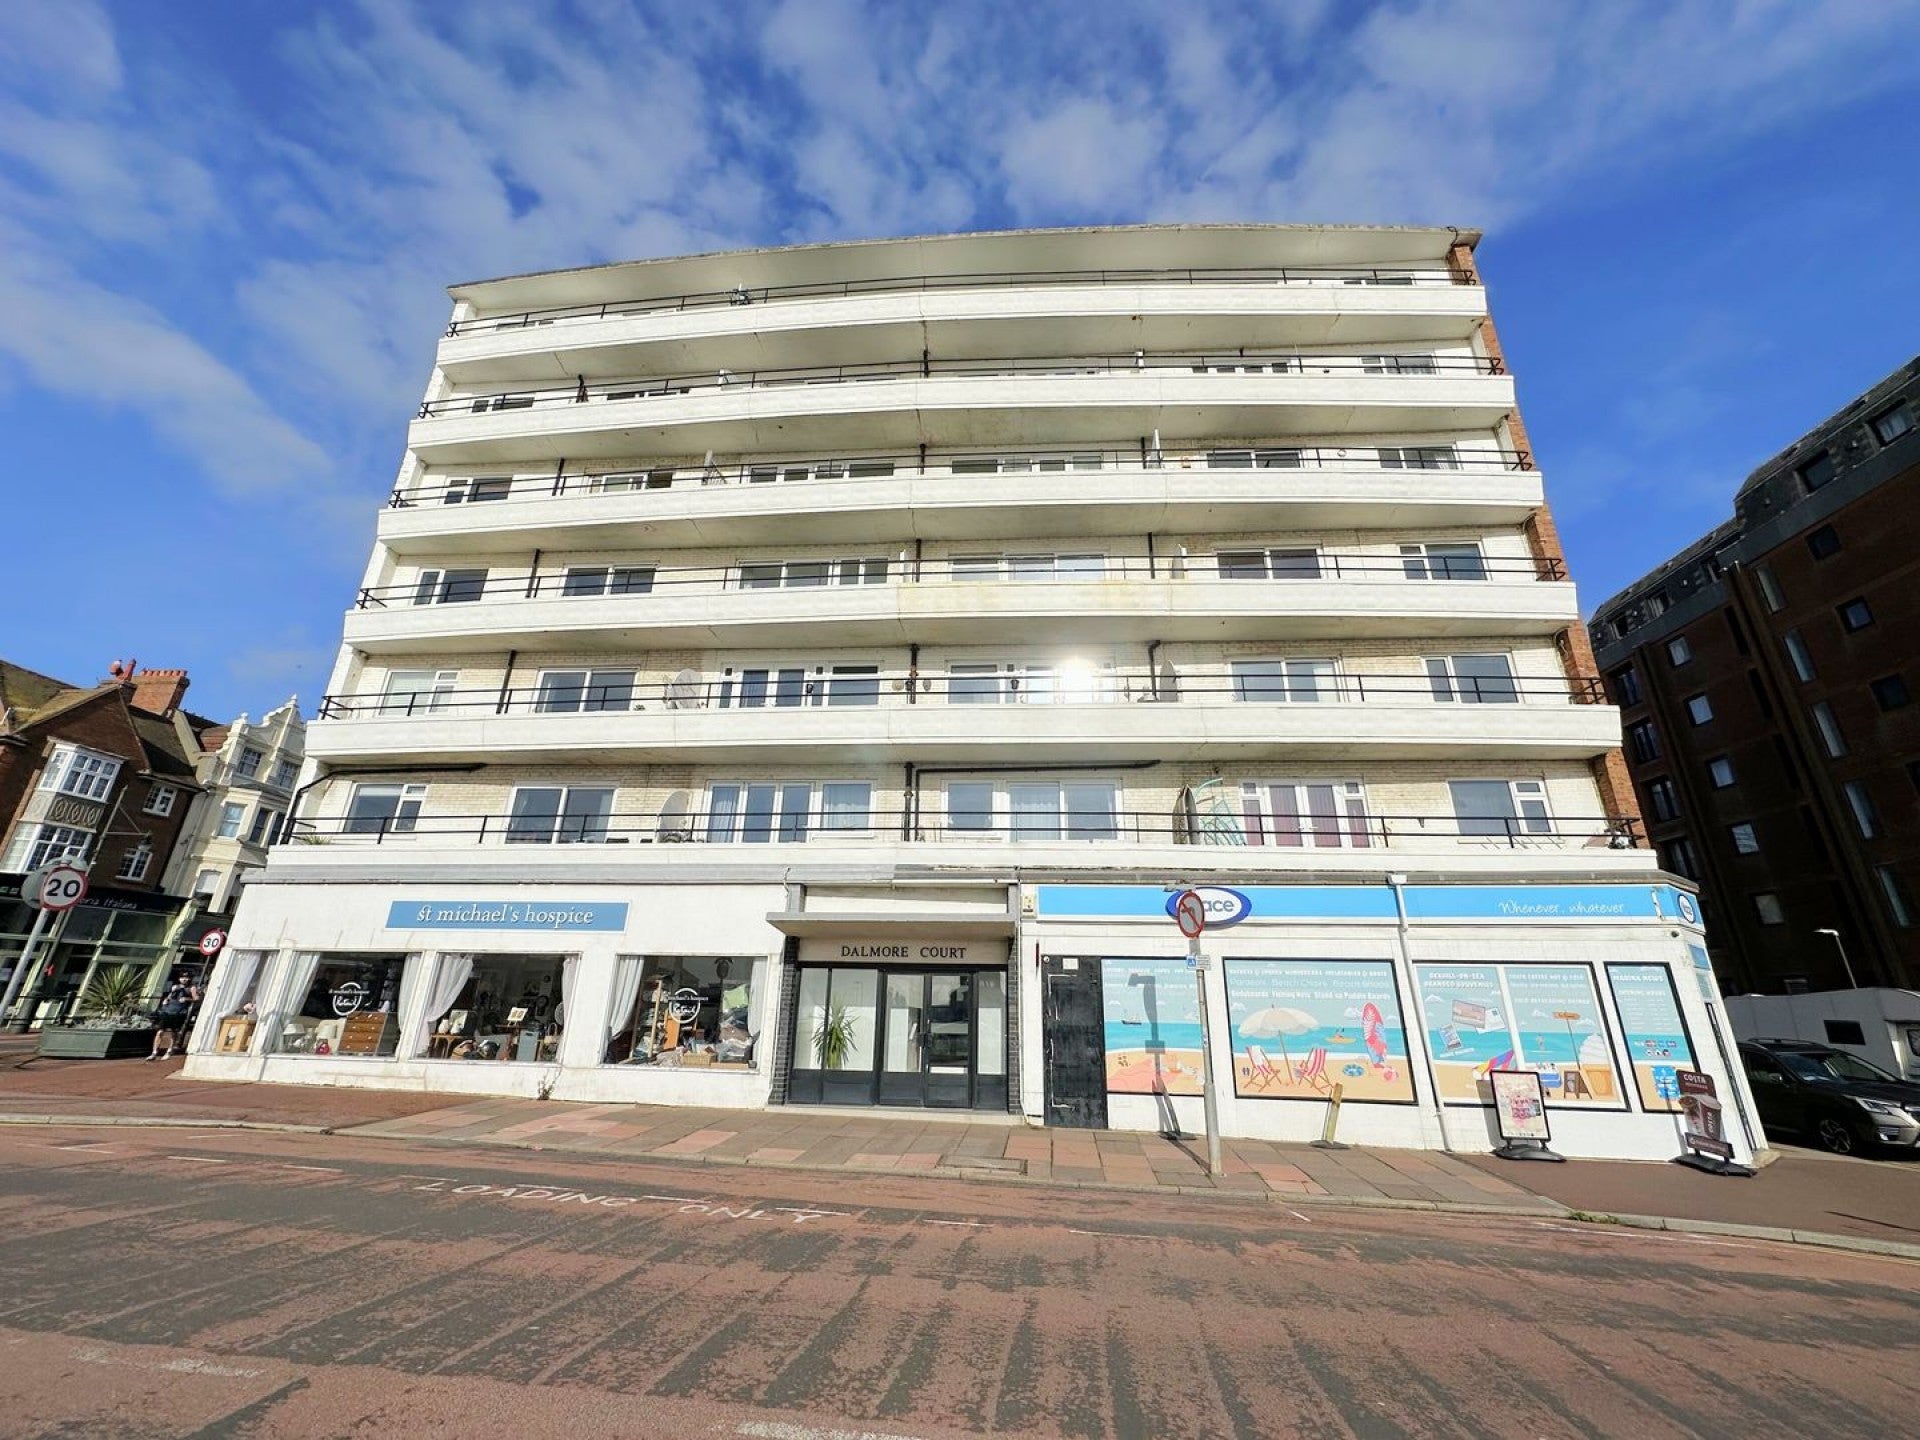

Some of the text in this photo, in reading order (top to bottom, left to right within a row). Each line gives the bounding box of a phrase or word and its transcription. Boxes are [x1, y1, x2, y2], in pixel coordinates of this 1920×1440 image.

[46, 878, 81, 898] 20
[1568, 900, 1624, 914] whatever
[417, 903, 593, 928] st michael's hospice
[203, 938, 219, 948] 30
[841, 946, 967, 959] DALMORE COURT
[1683, 1074, 1706, 1084] COSTA
[415, 1182, 822, 1224] LOADING ONLY
